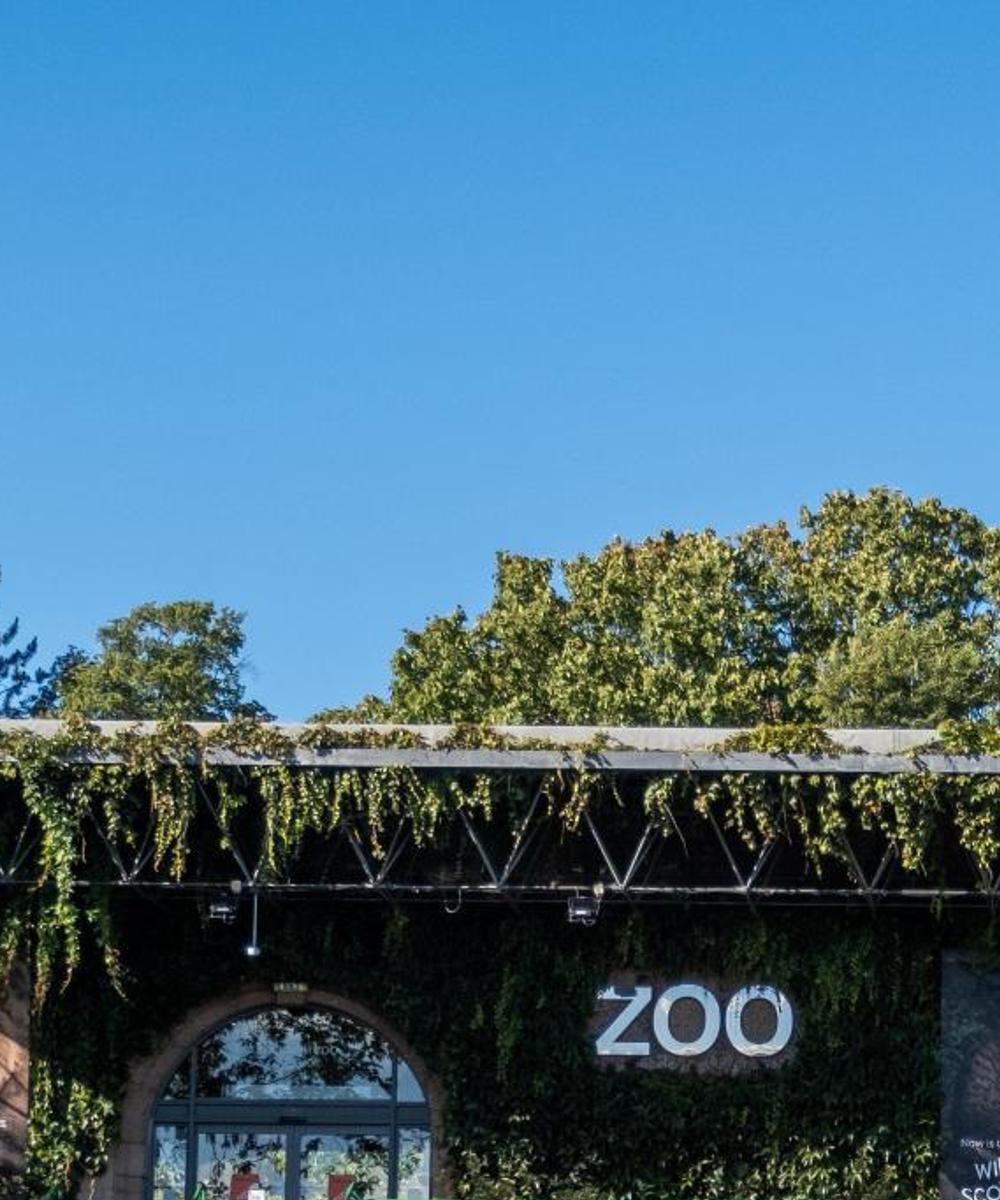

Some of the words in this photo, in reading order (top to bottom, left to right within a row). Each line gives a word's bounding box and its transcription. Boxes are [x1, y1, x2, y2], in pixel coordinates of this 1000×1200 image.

[595, 983, 794, 1057] ZOO
[961, 1138, 984, 1149] Now
[986, 1139, 994, 1149] is
